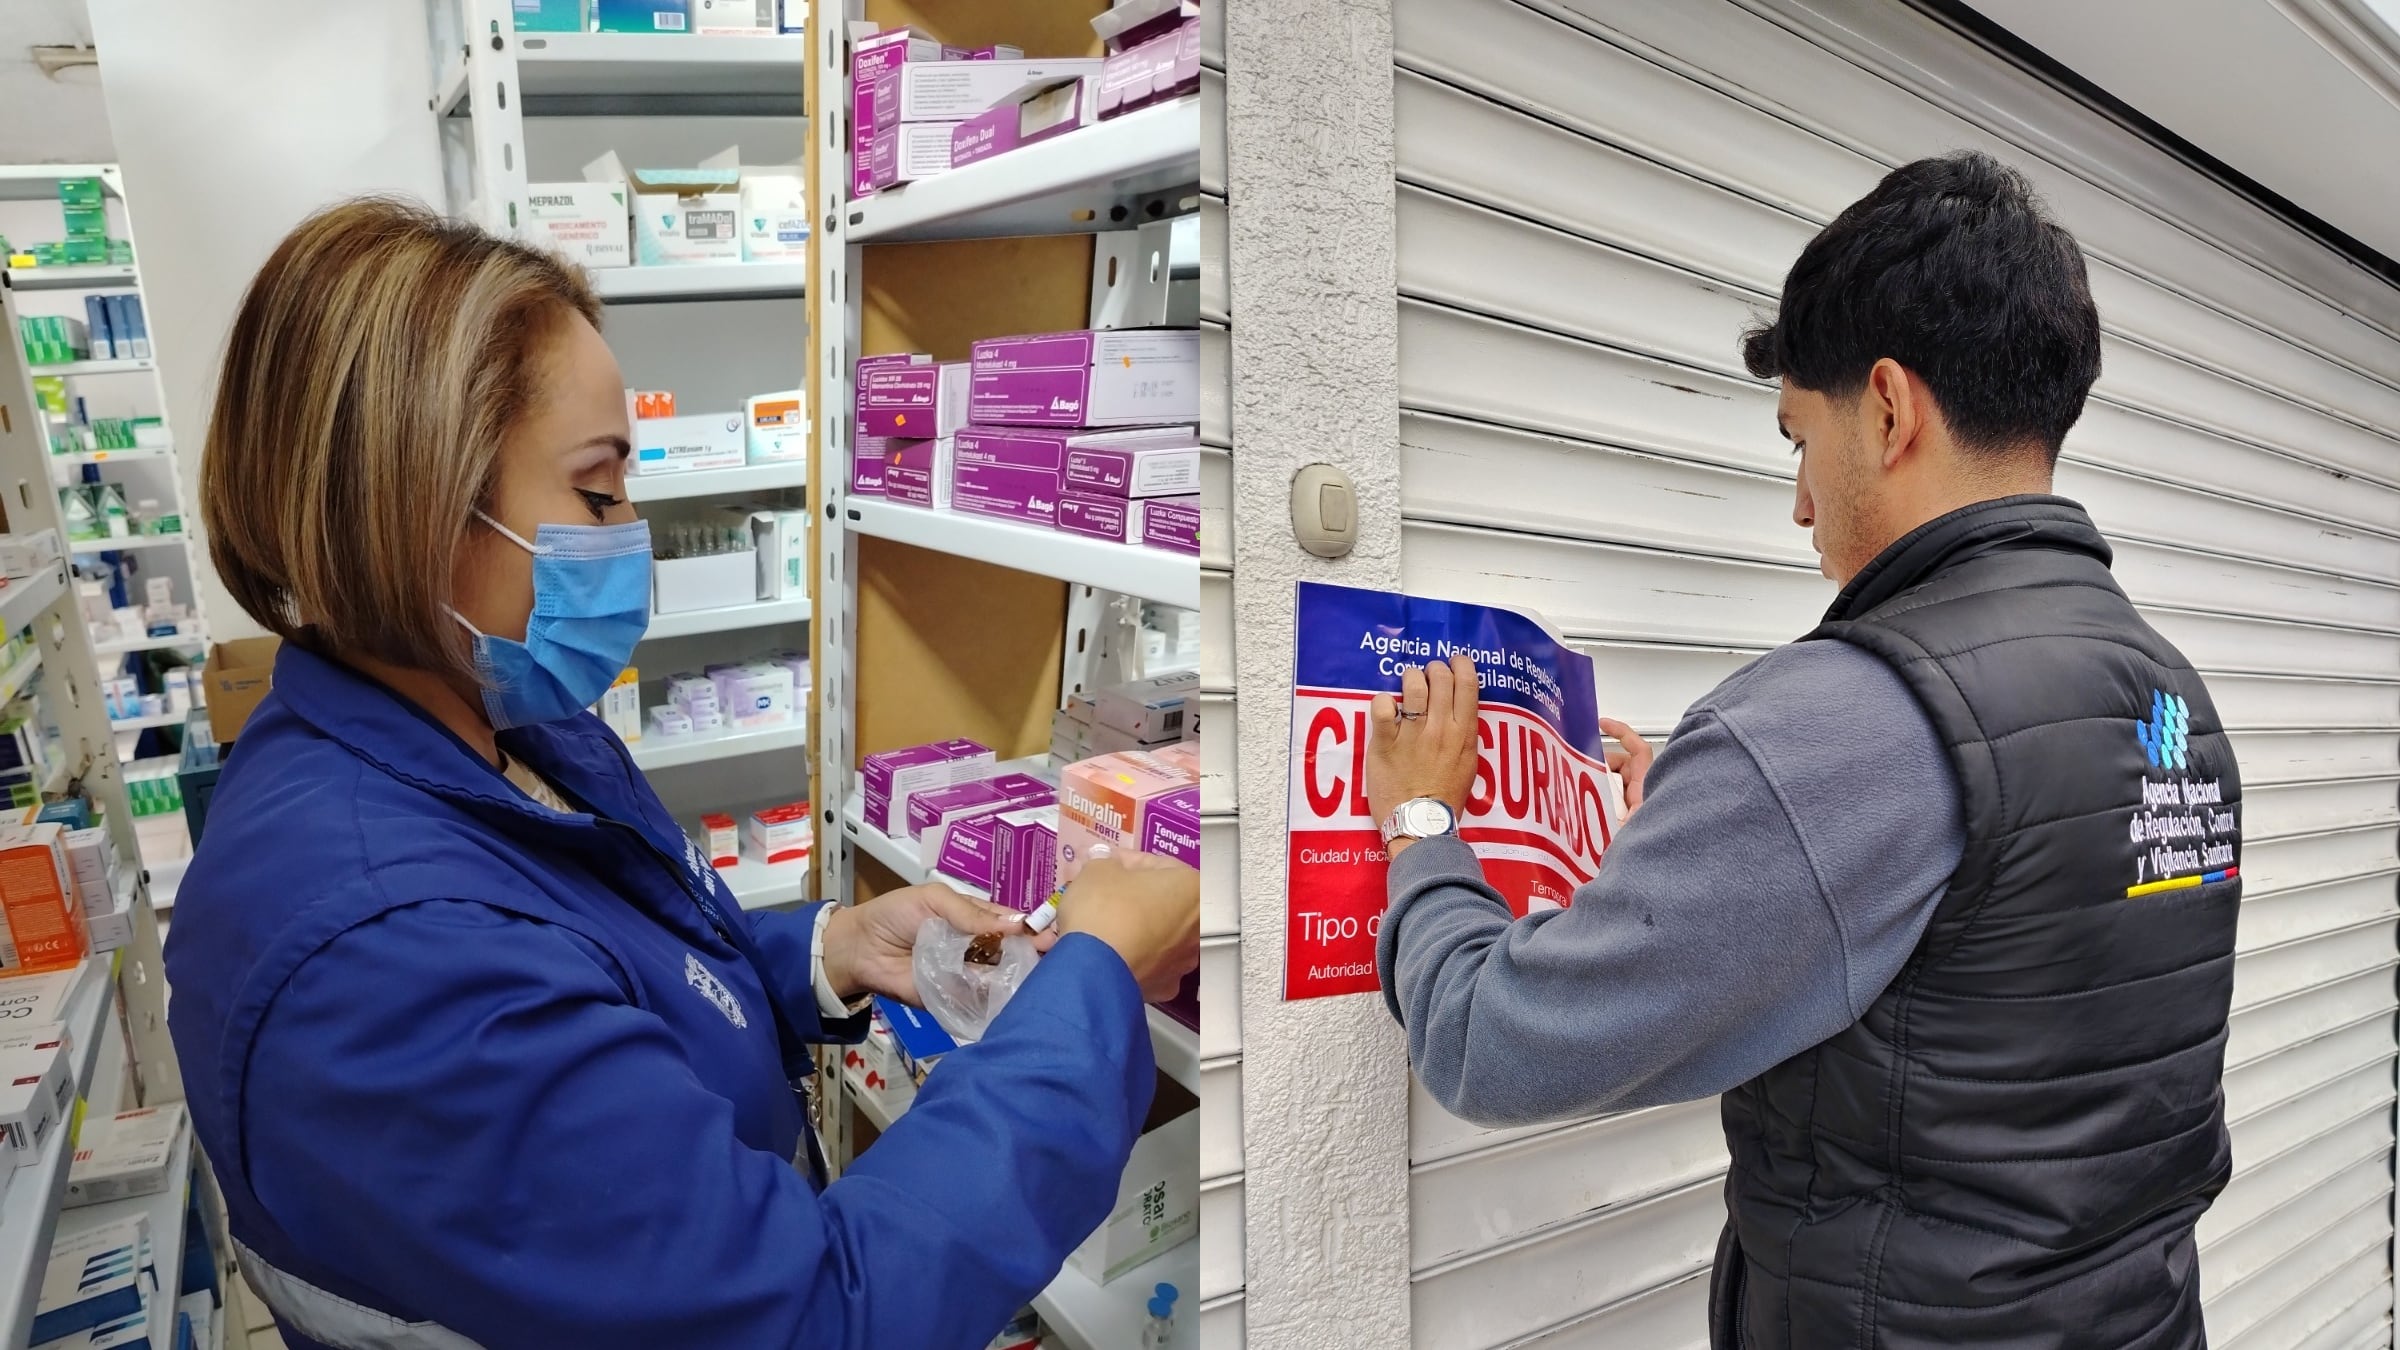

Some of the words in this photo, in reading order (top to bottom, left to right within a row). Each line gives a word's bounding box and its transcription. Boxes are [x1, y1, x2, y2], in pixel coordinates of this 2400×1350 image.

[980, 124, 995, 141] Dual
[528, 195, 575, 207] MEPRAZOL
[548, 221, 608, 230] MEDICAMENTO
[688, 213, 732, 225] traMADol
[1059, 400, 1079, 412] Bagó
[1035, 499, 1054, 513] Bagó
[1167, 511, 1200, 524] Compuesto
[1360, 632, 1431, 655] Agencia
[1437, 640, 1506, 666] Nacional
[1509, 651, 1524, 671] de
[1304, 706, 1612, 869] CLSURADO
[2142, 775, 2181, 811] Agencia
[2181, 776, 2222, 806] Nacional
[1094, 822, 1121, 842] FORTE
[2130, 812, 2146, 843] de
[2145, 809, 2206, 845] Regulación,
[951, 830, 978, 850] Prestat
[1152, 834, 1180, 855] Forte
[1300, 848, 1350, 864] Ciudad
[1352, 851, 1362, 866] y
[1364, 847, 1388, 862] fec
[2137, 855, 2147, 884] y
[2150, 846, 2200, 879] Vigilancia
[2201, 839, 2234, 867] Sanitaria
[1531, 879, 1567, 907] Tempora
[1297, 911, 1359, 947] Tipo
[1366, 908, 1384, 938] d
[1307, 960, 1374, 981] Autoridad
